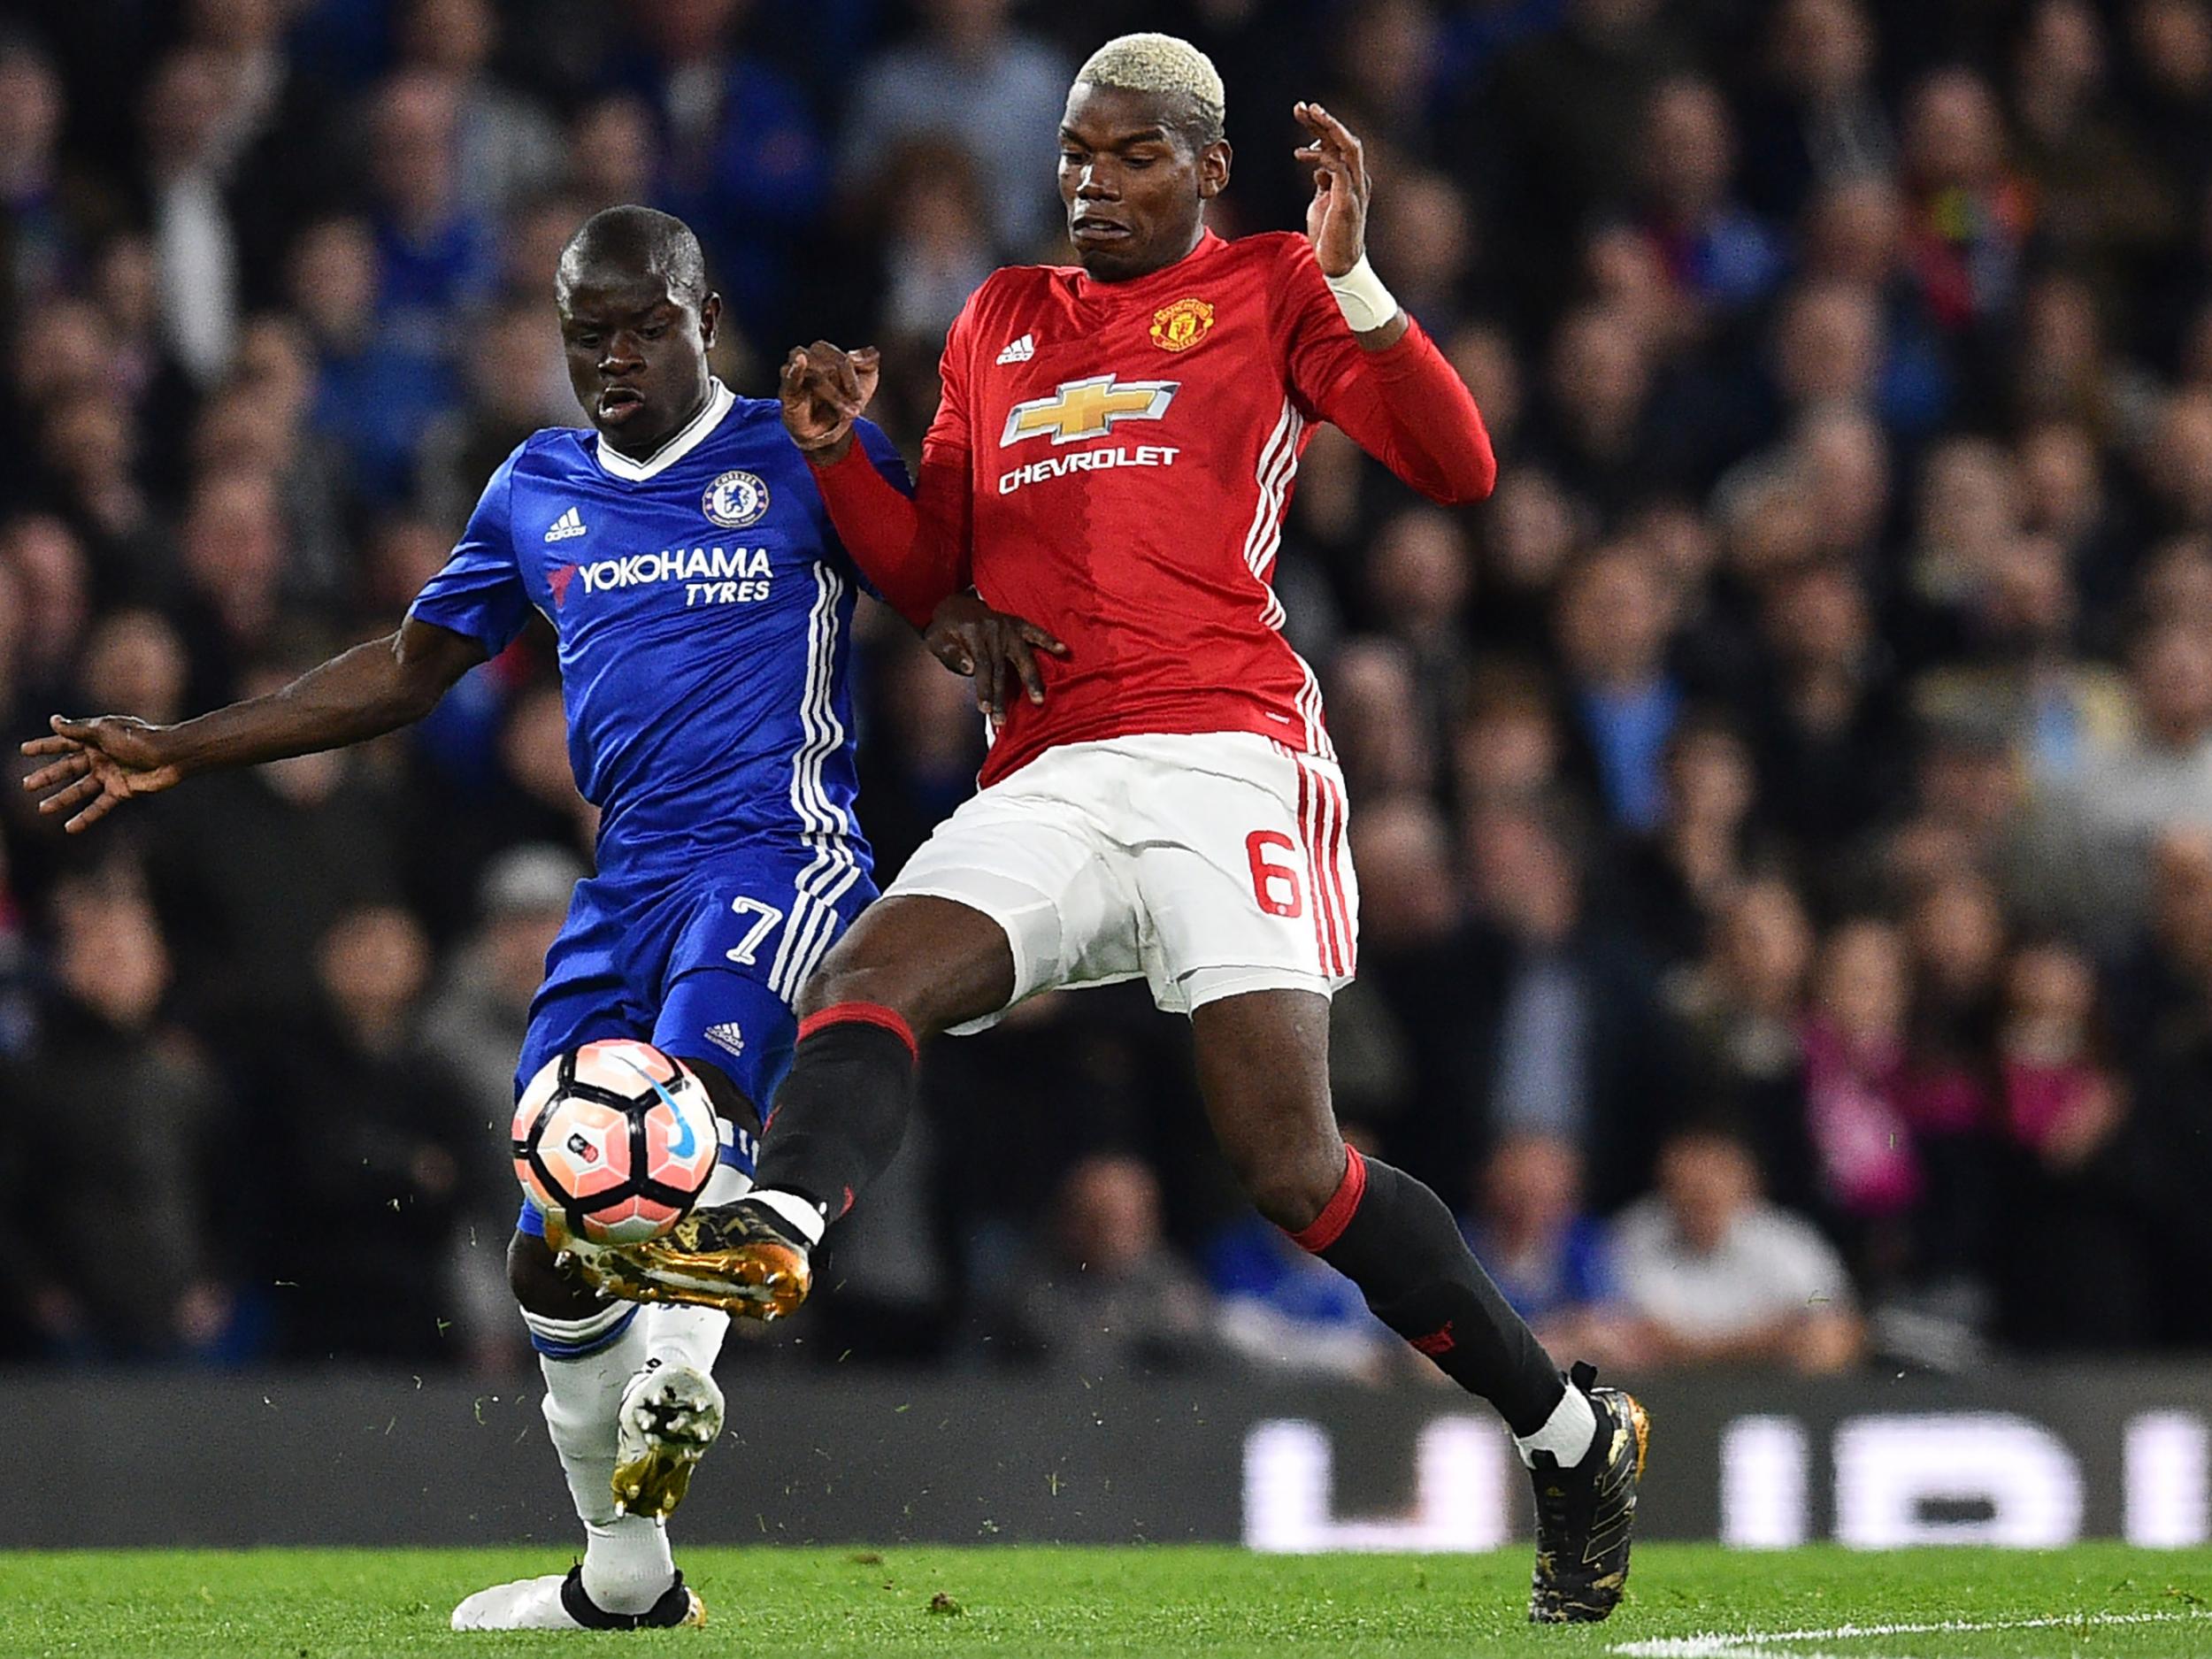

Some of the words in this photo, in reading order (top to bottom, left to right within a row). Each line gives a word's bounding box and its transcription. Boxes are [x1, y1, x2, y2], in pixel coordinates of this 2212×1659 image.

[999, 445, 1180, 495] CHEVROLET
[544, 525, 588, 543] adidas
[579, 547, 774, 595] YOKOHAMA
[685, 580, 771, 607] TYRES
[1245, 829, 1302, 918] 6
[725, 895, 784, 966] 7
